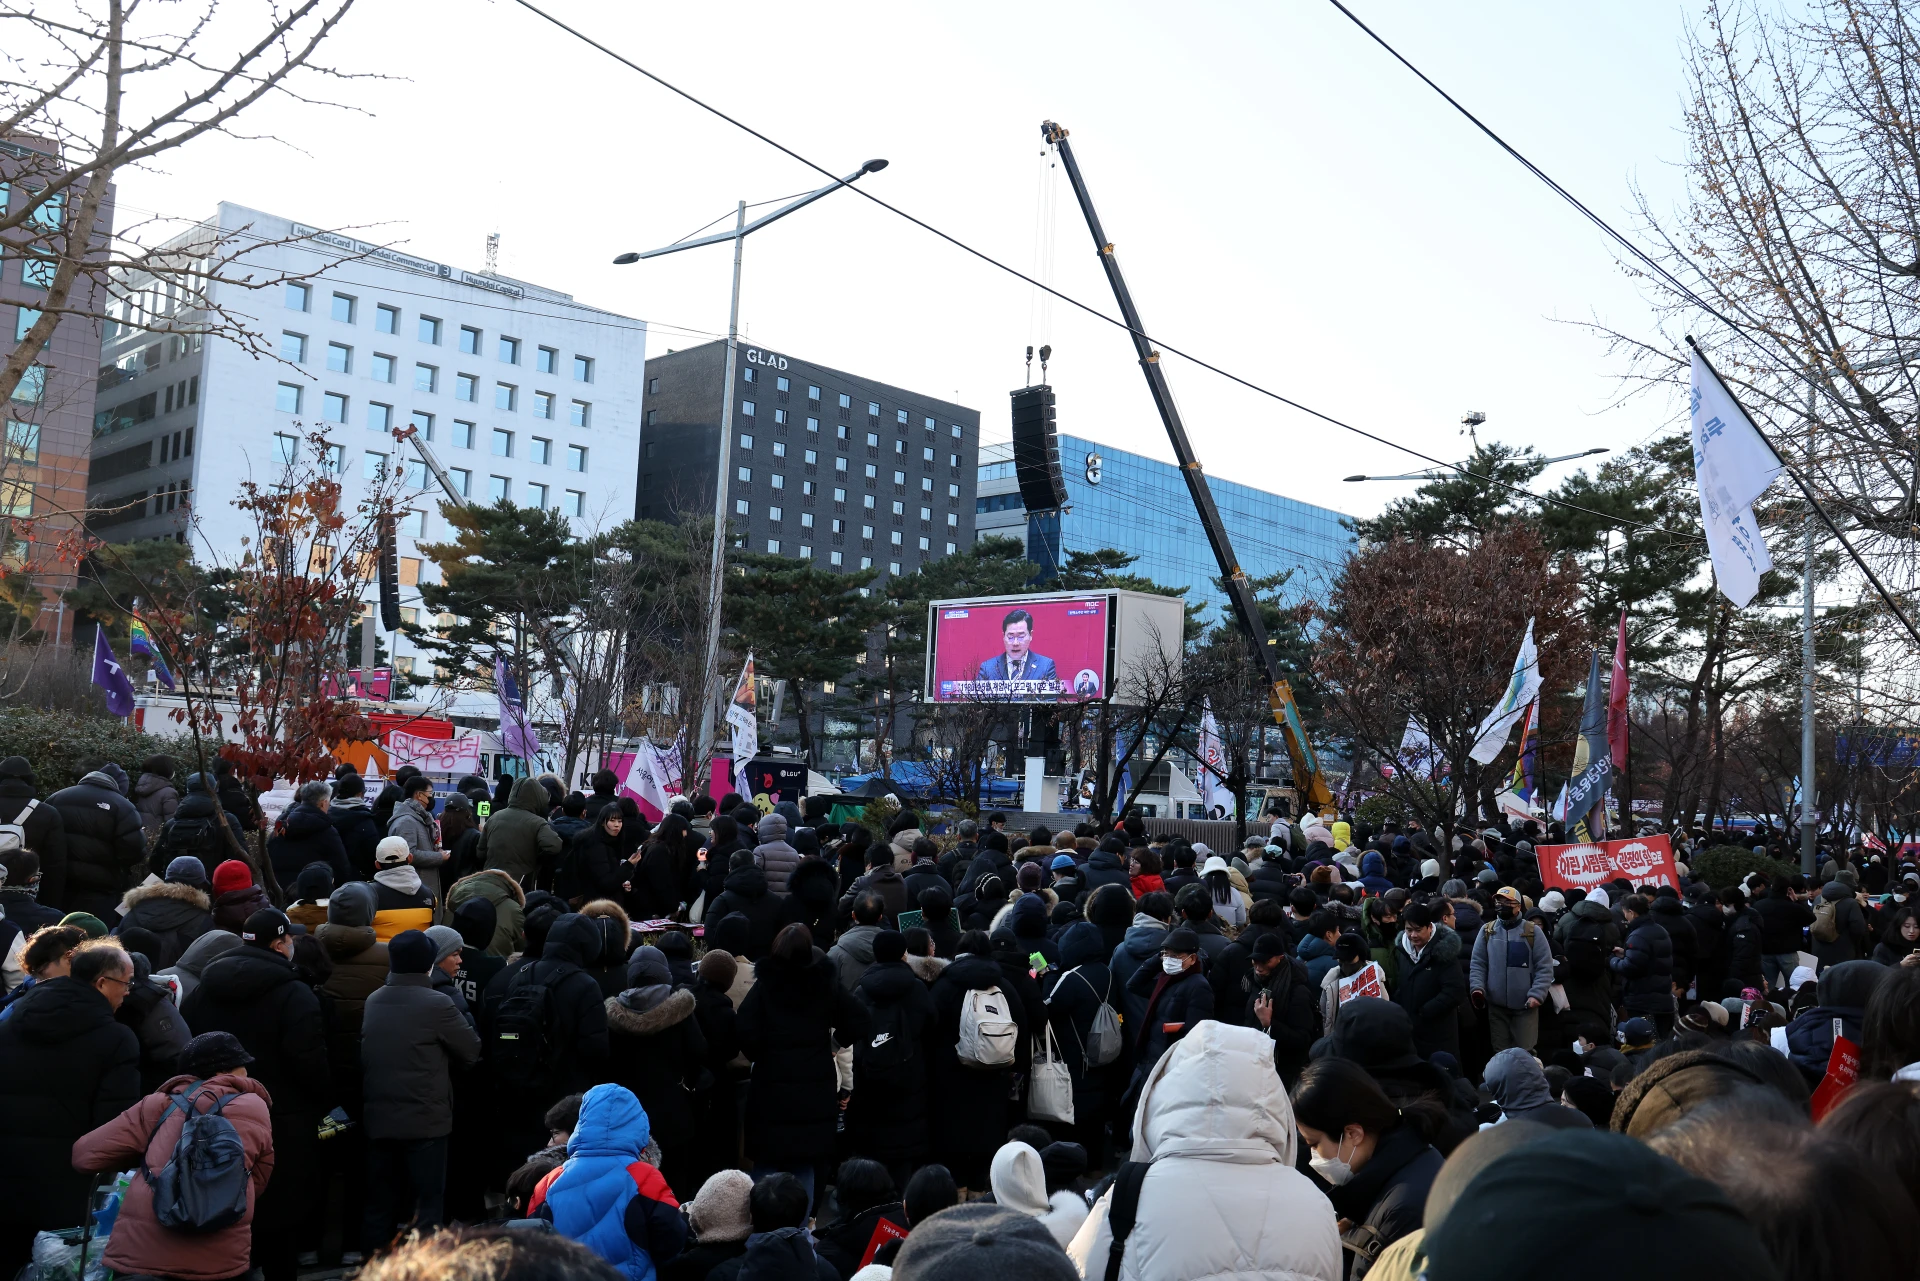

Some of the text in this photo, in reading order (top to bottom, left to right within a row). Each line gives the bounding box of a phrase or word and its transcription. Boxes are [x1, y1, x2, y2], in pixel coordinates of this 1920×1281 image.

[297, 226, 351, 250] Hyundai Card
[358, 243, 436, 273] Hyundai Commercial
[466, 274, 521, 298] Hyundai Capital
[746, 349, 788, 371] GLAD
